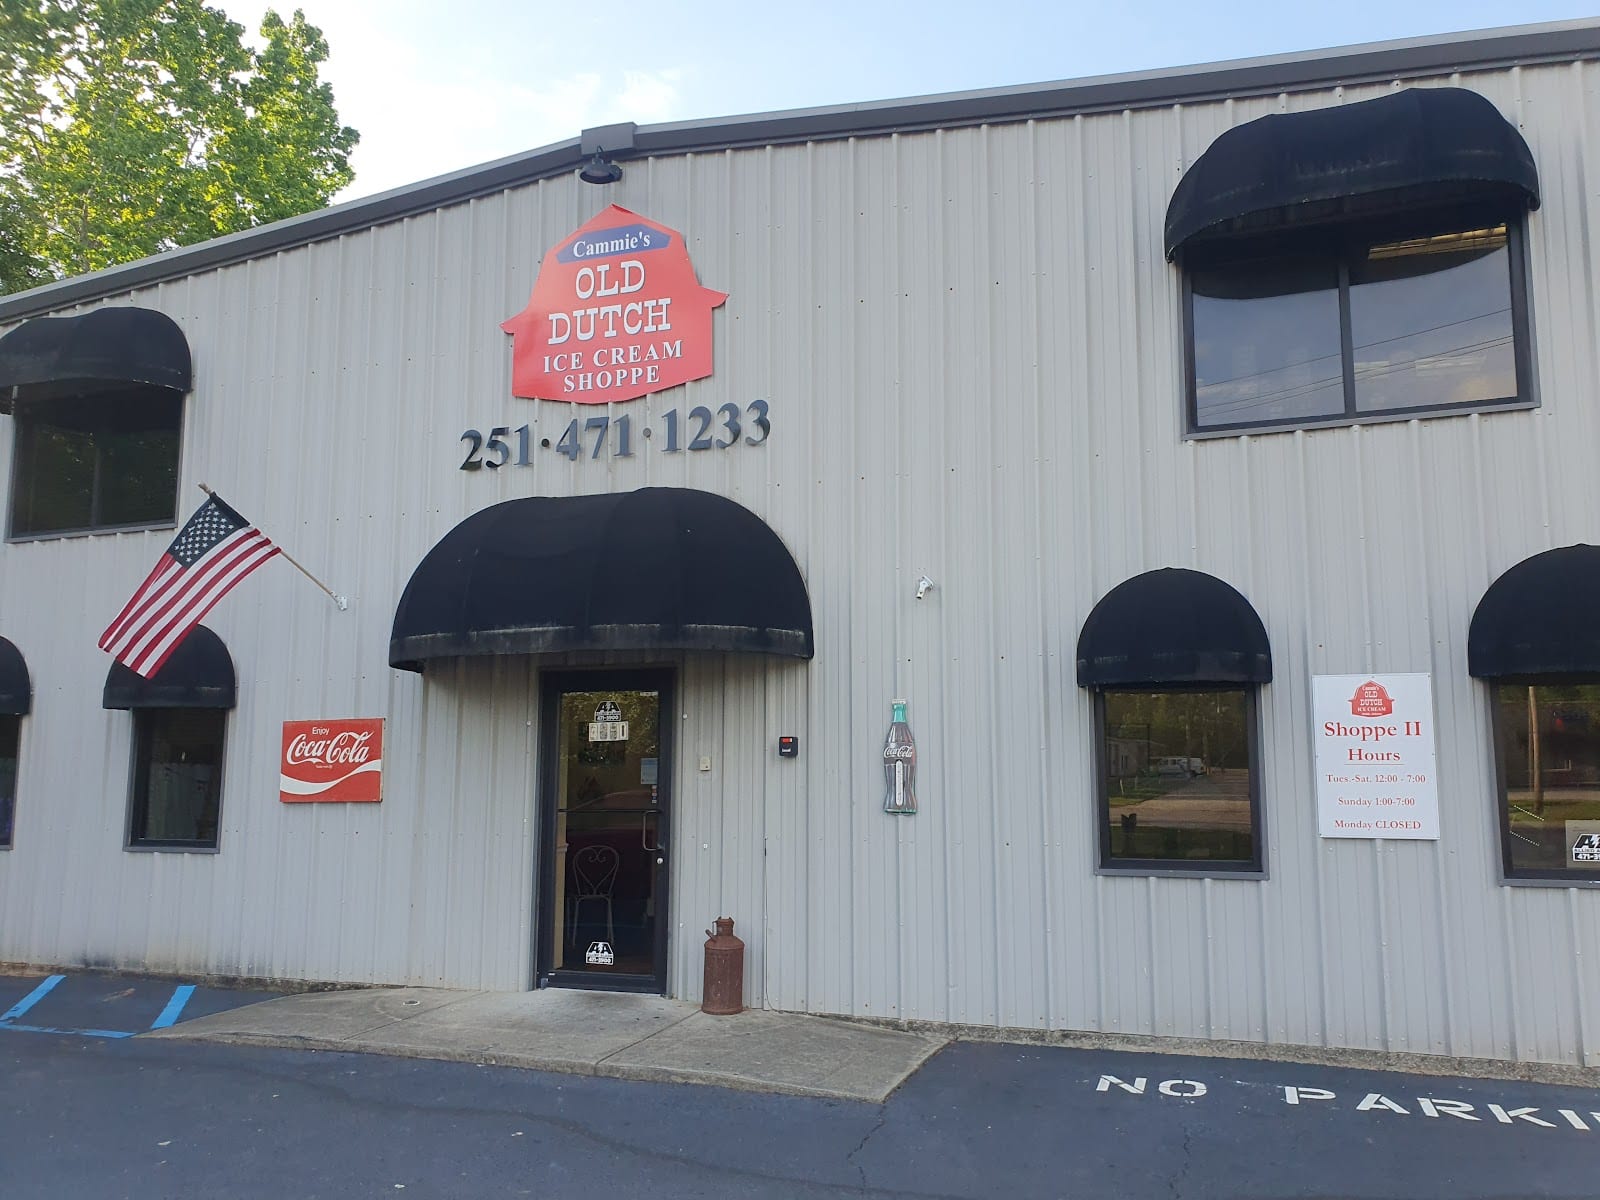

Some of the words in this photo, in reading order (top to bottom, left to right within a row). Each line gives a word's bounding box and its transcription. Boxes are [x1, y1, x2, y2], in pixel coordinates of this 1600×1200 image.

[573, 231, 650, 258] Cammie's
[575, 259, 645, 299] OLD
[548, 297, 671, 345] DUTCH
[543, 351, 584, 373] ICE
[593, 340, 682, 367] CREAM
[564, 365, 660, 393] SHOPPE
[312, 727, 329, 735] Enjoy
[1324, 721, 1397, 741] Shoppe
[1405, 721, 1421, 736] II
[286, 731, 375, 765] Coca-Cola
[1348, 749, 1400, 761] Hours
[1375, 774, 1398, 783] 12:00
[1407, 774, 1426, 783] 7:00
[1338, 797, 1372, 807] Sunday
[1335, 820, 1373, 831] Monday
[1375, 820, 1421, 829] CLOSED
[1096, 1074, 1207, 1097] NO
